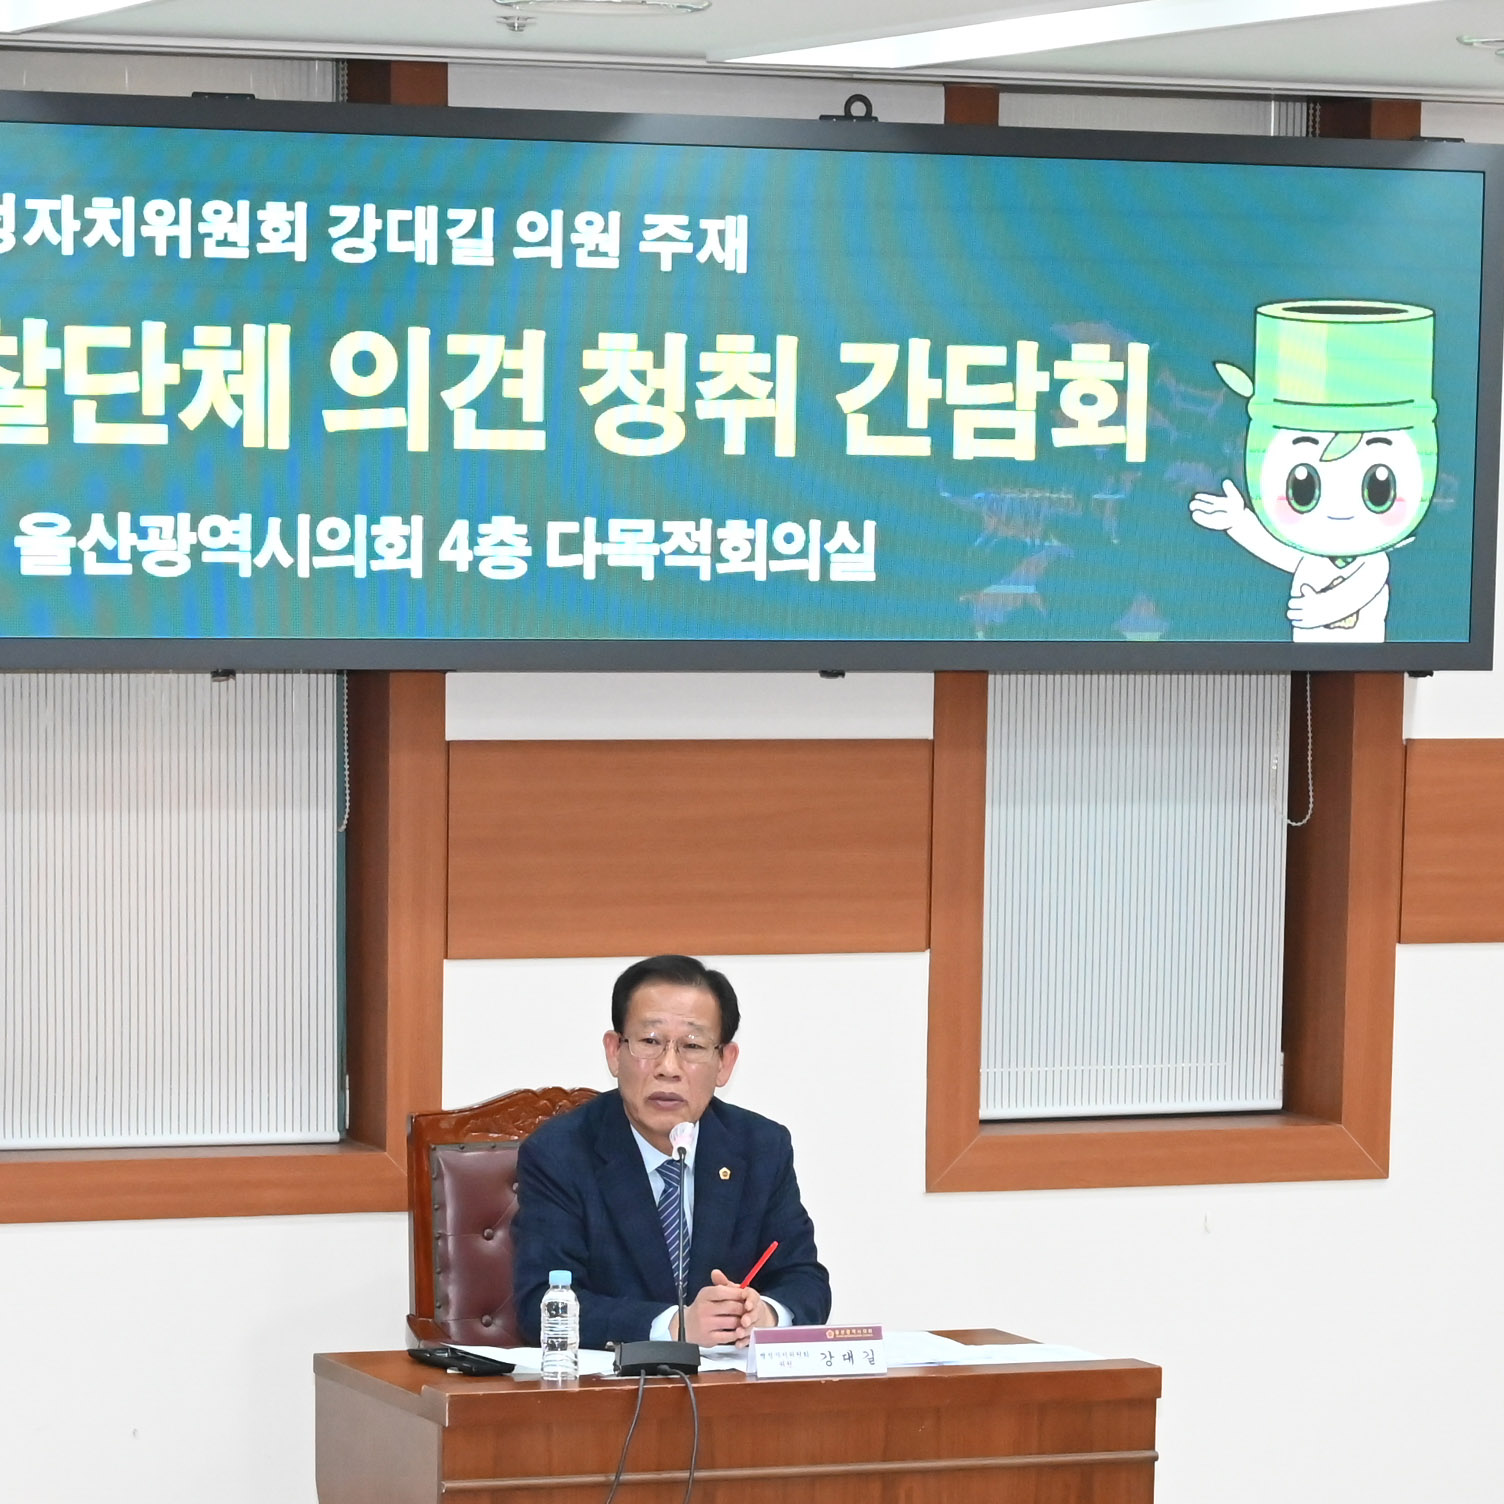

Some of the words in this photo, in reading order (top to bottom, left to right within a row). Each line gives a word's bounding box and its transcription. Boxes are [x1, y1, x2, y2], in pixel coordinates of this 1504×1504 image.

[329, 203, 494, 266] 강대길
[513, 209, 620, 268] 의원
[640, 214, 747, 273] 주재
[323, 326, 545, 452] 의견
[579, 332, 798, 458] 청취
[835, 337, 1149, 463] 간담회
[14, 511, 424, 579] 울산광역시의회
[438, 516, 532, 580] 4층
[546, 516, 877, 582] 다목적회의실
